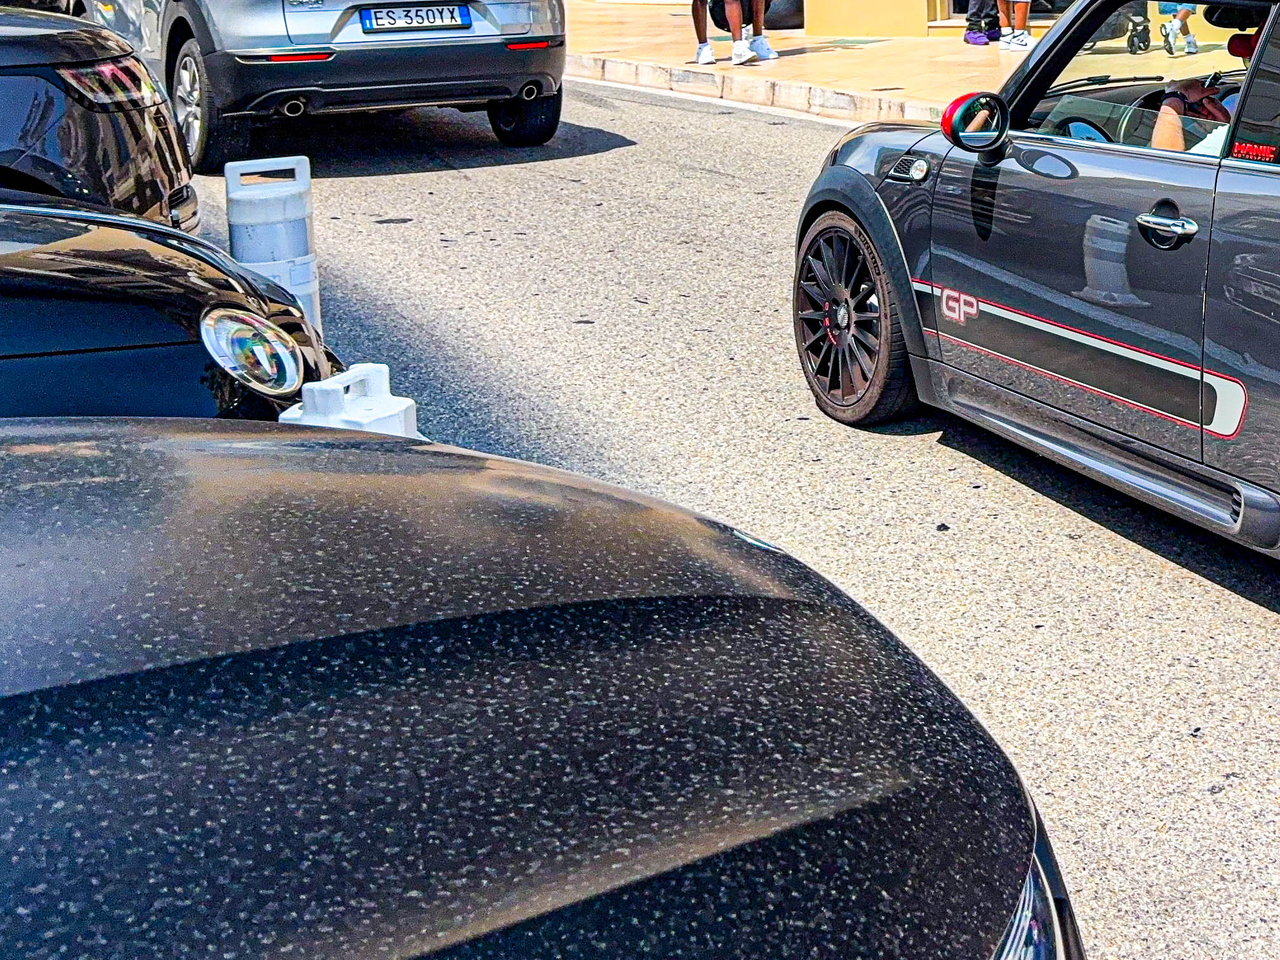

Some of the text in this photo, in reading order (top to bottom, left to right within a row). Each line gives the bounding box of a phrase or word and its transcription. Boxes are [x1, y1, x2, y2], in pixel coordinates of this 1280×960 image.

[374, 7, 459, 27] ES 350YX
[941, 287, 979, 324] GP
